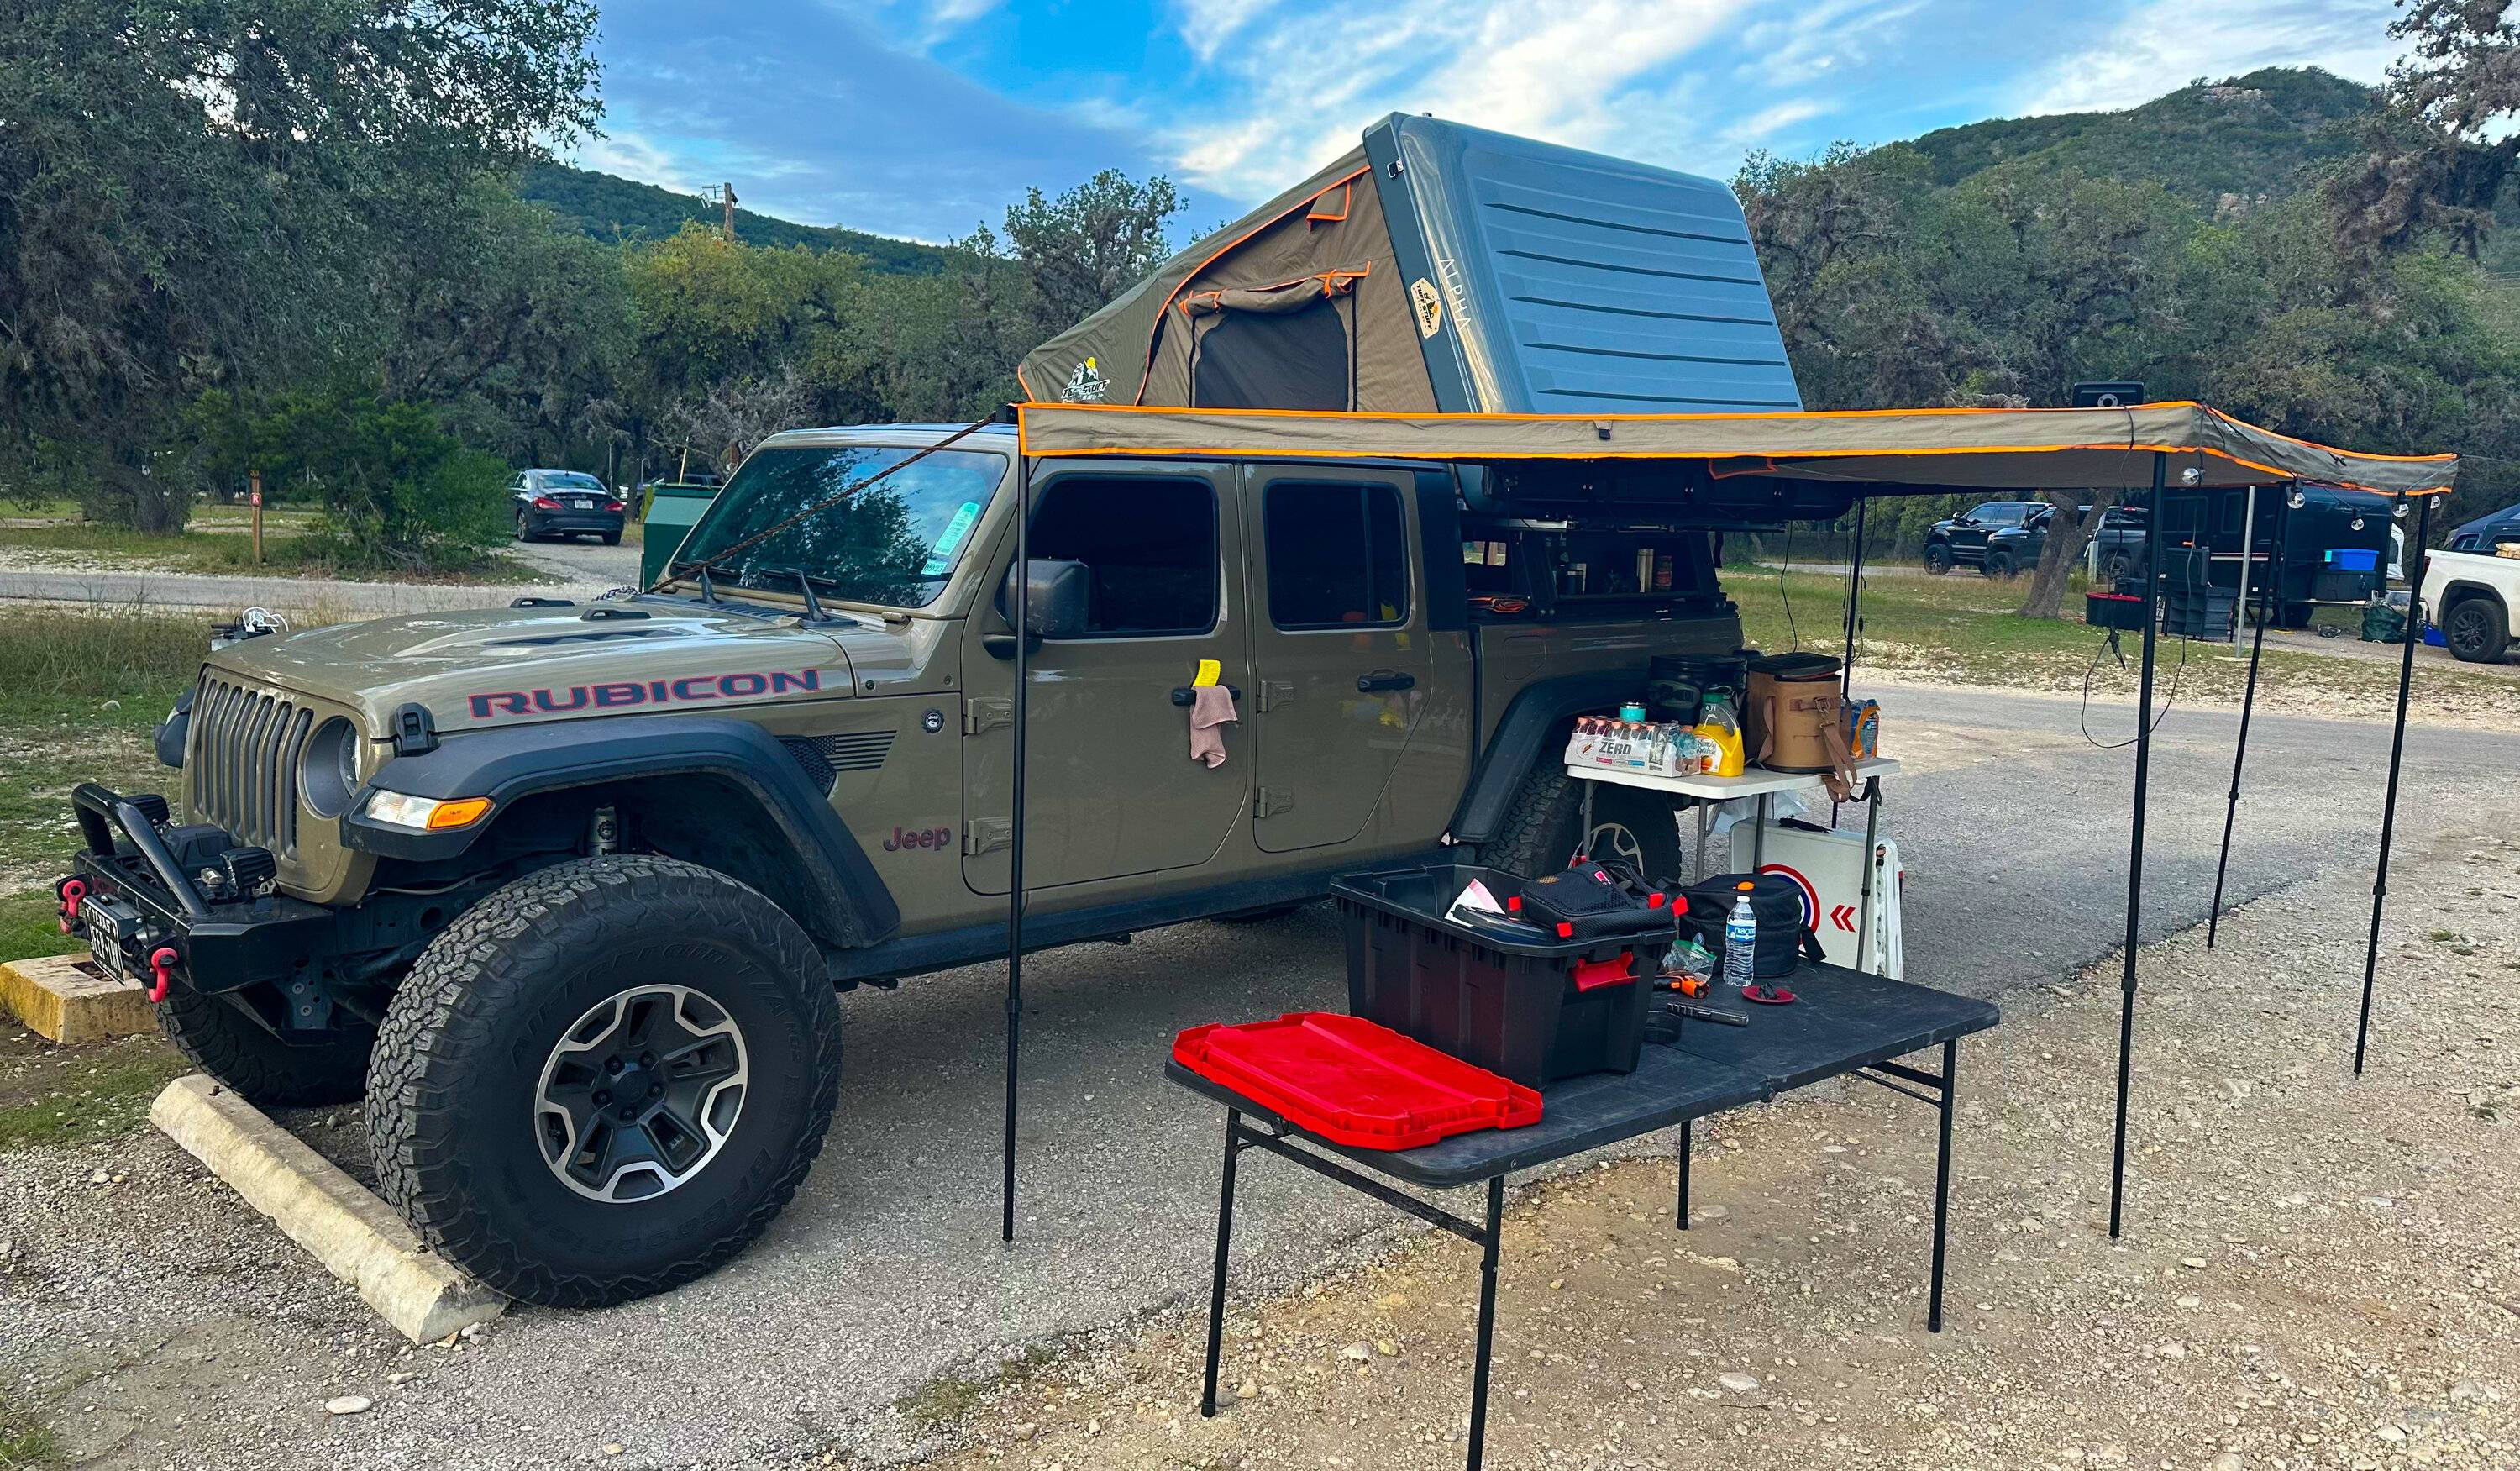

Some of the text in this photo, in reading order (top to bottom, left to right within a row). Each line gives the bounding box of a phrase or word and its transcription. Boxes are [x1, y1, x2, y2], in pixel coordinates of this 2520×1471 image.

[1440, 258, 1471, 332] ALPHA
[468, 669, 821, 720] RUBICON
[1599, 741, 1632, 755] ZERO
[883, 826, 951, 852] Jeep
[92, 908, 111, 933] TEXAS
